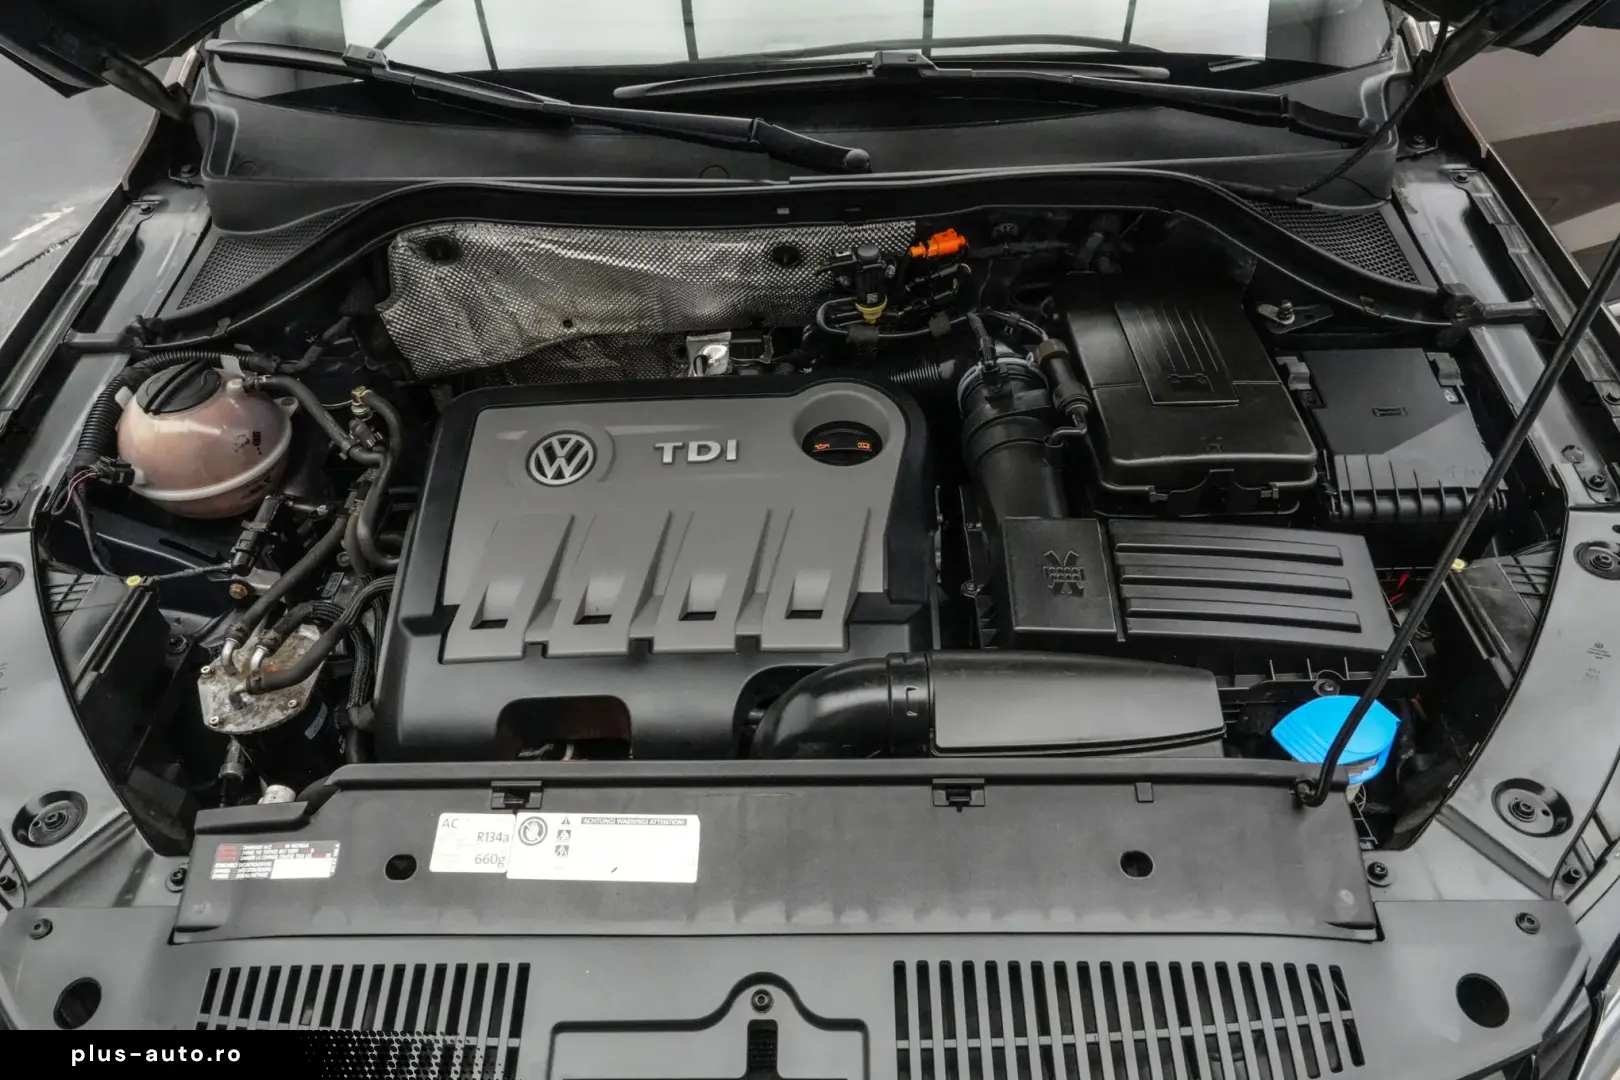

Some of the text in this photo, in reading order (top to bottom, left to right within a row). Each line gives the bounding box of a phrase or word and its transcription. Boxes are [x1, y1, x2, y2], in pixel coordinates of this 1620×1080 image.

[655, 439, 738, 464] TDI
[530, 433, 593, 486] VW
[441, 817, 460, 829] AC
[583, 817, 615, 825] ACHTUNG!
[649, 818, 685, 826] ATTENTION!
[476, 831, 510, 843] R134a
[474, 853, 507, 869] 660g
